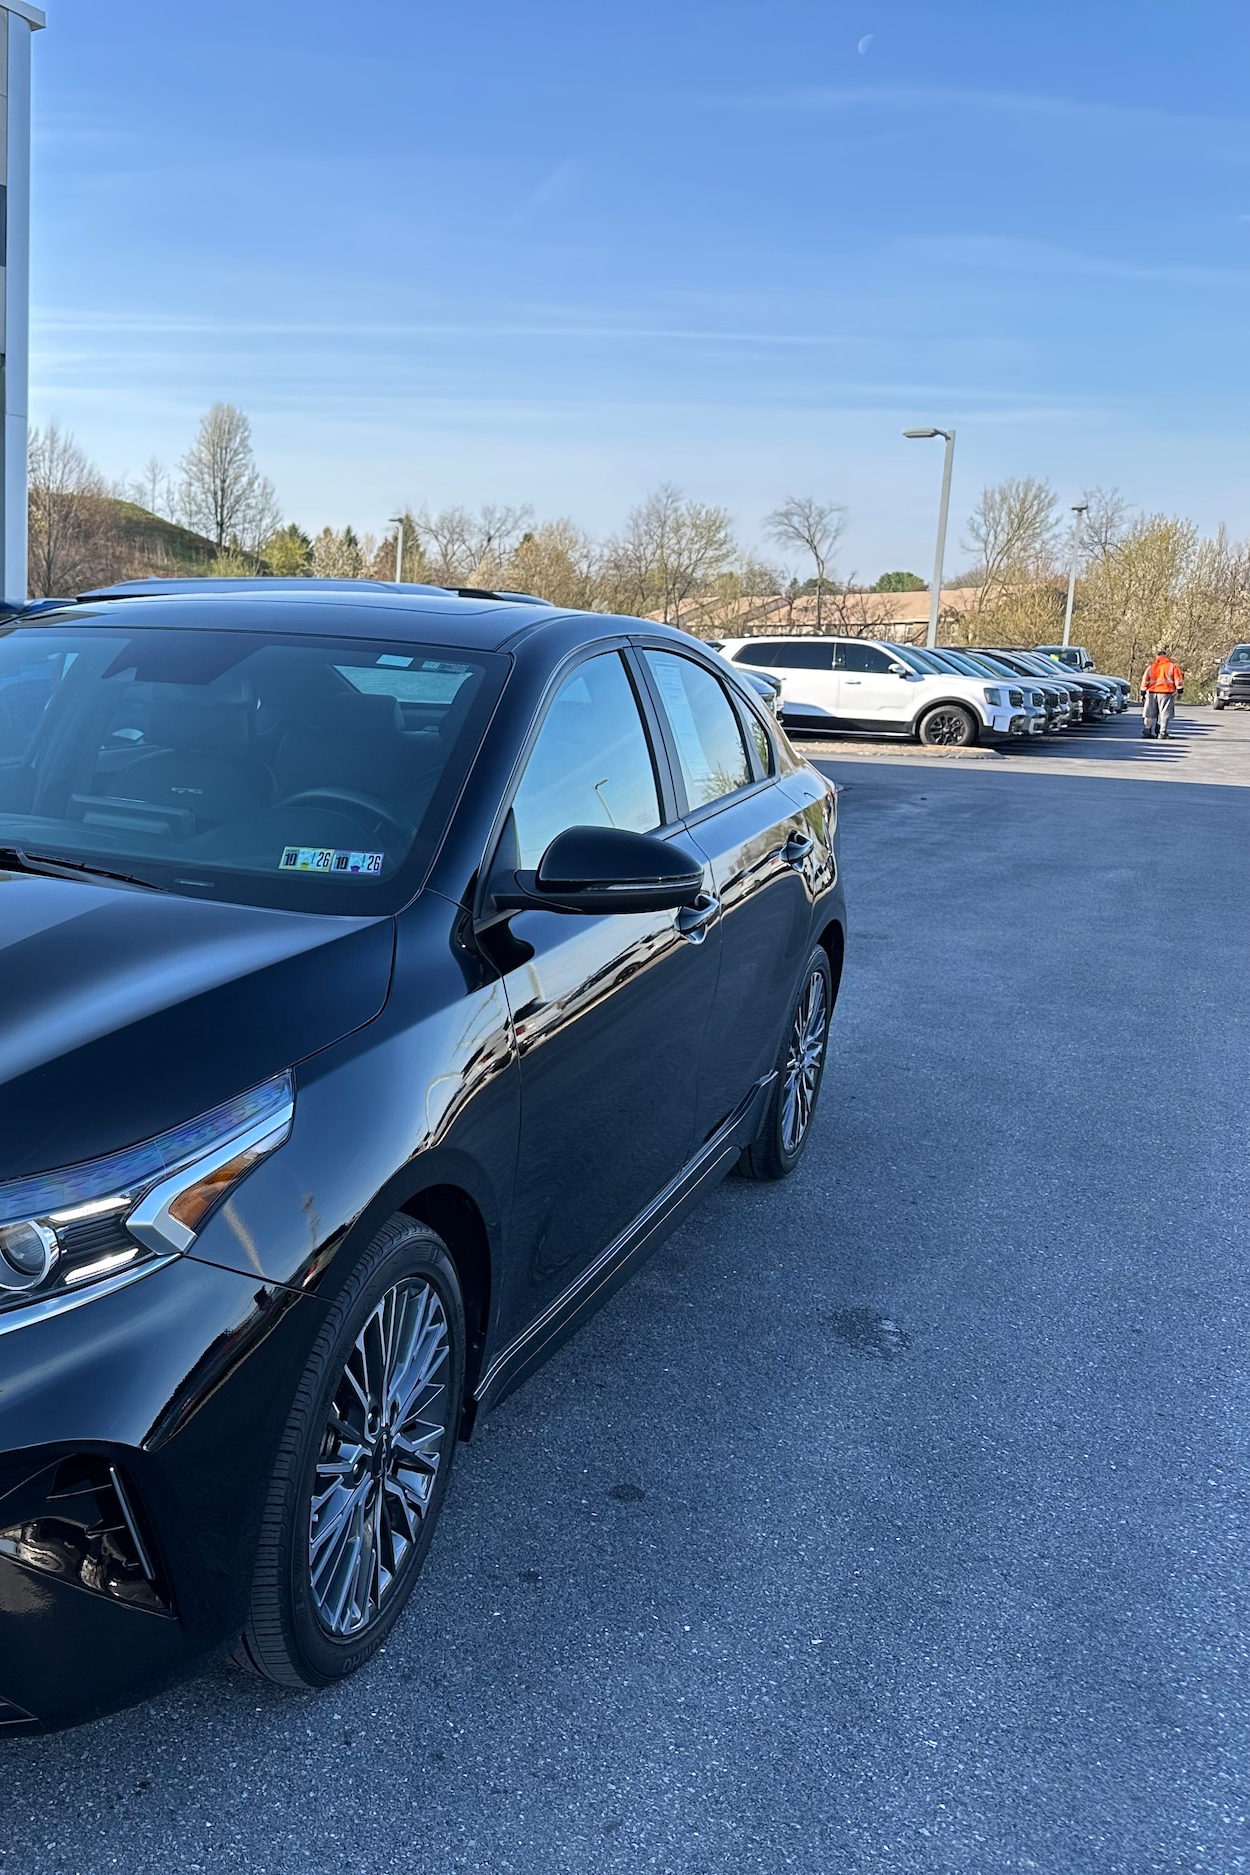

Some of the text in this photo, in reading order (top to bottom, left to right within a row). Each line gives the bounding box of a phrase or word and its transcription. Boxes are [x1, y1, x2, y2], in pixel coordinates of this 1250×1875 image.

[284, 851, 331, 868] 10 26
[335, 855, 381, 871] 10 26
